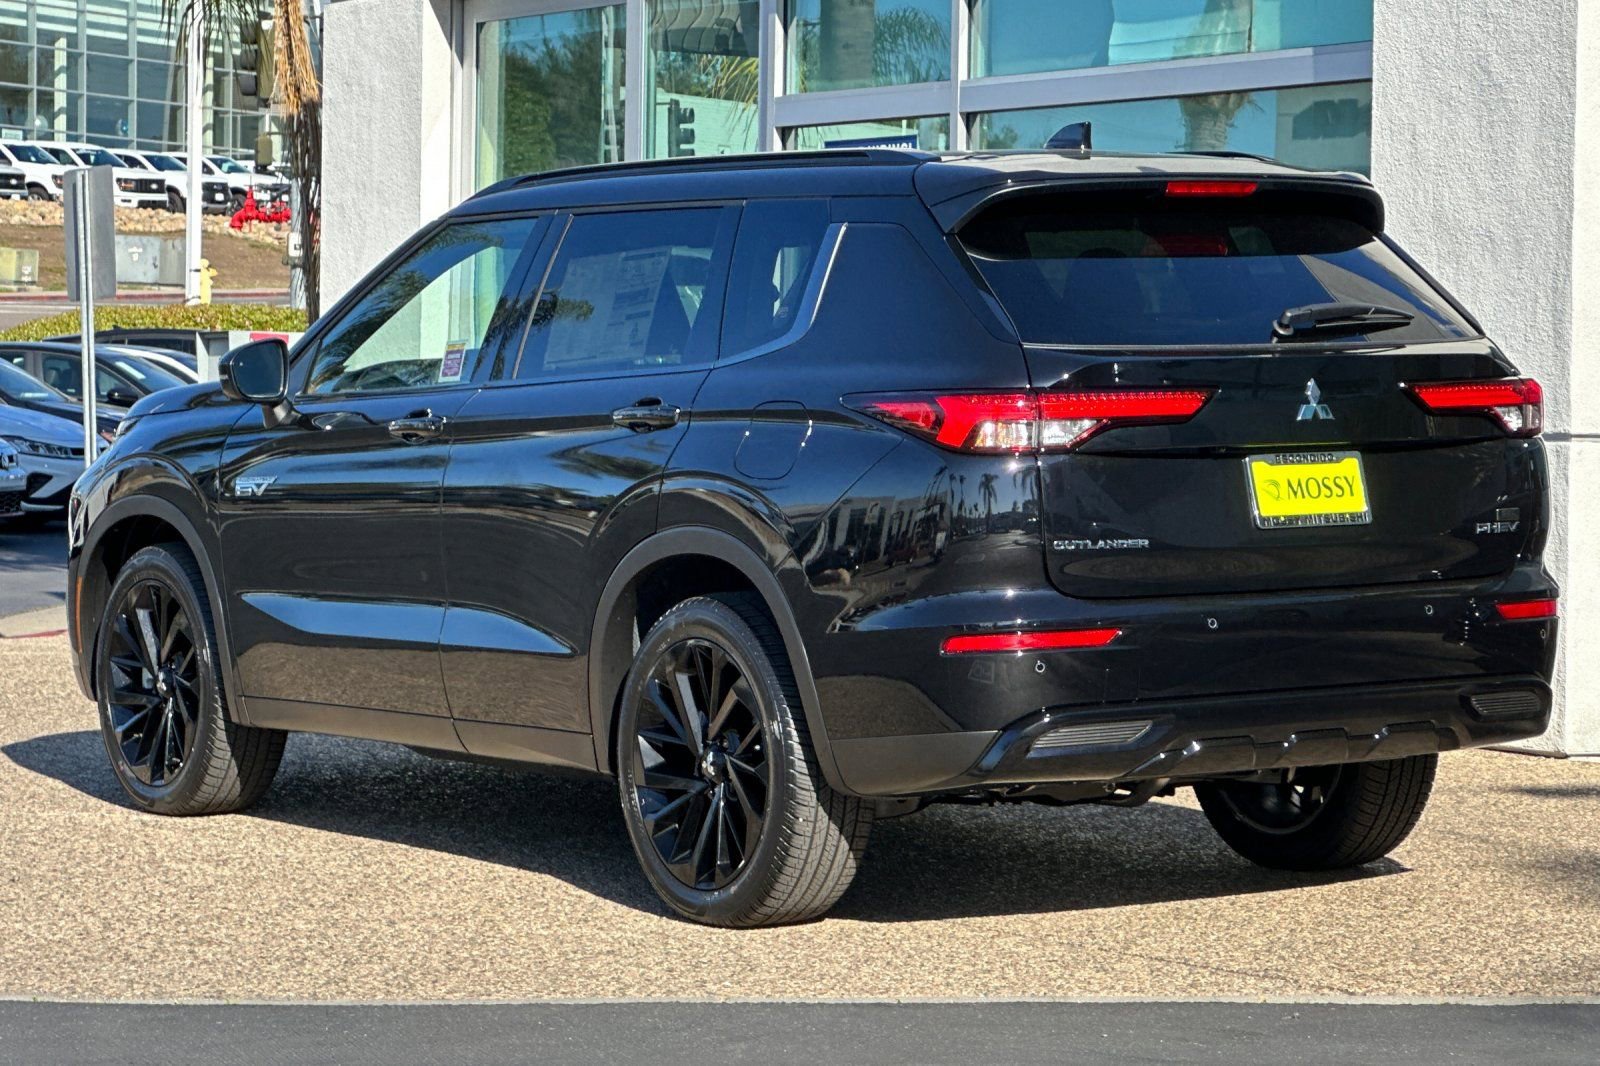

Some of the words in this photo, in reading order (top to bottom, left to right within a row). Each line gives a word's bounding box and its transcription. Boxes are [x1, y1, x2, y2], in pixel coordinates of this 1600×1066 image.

[1275, 453, 1334, 465] ESCONDIDO
[1287, 475, 1355, 500] MOSSY
[1304, 513, 1369, 525] MITSUBISHI
[1476, 522, 1520, 534] PHEV
[1053, 538, 1150, 550] OUTLANDER
